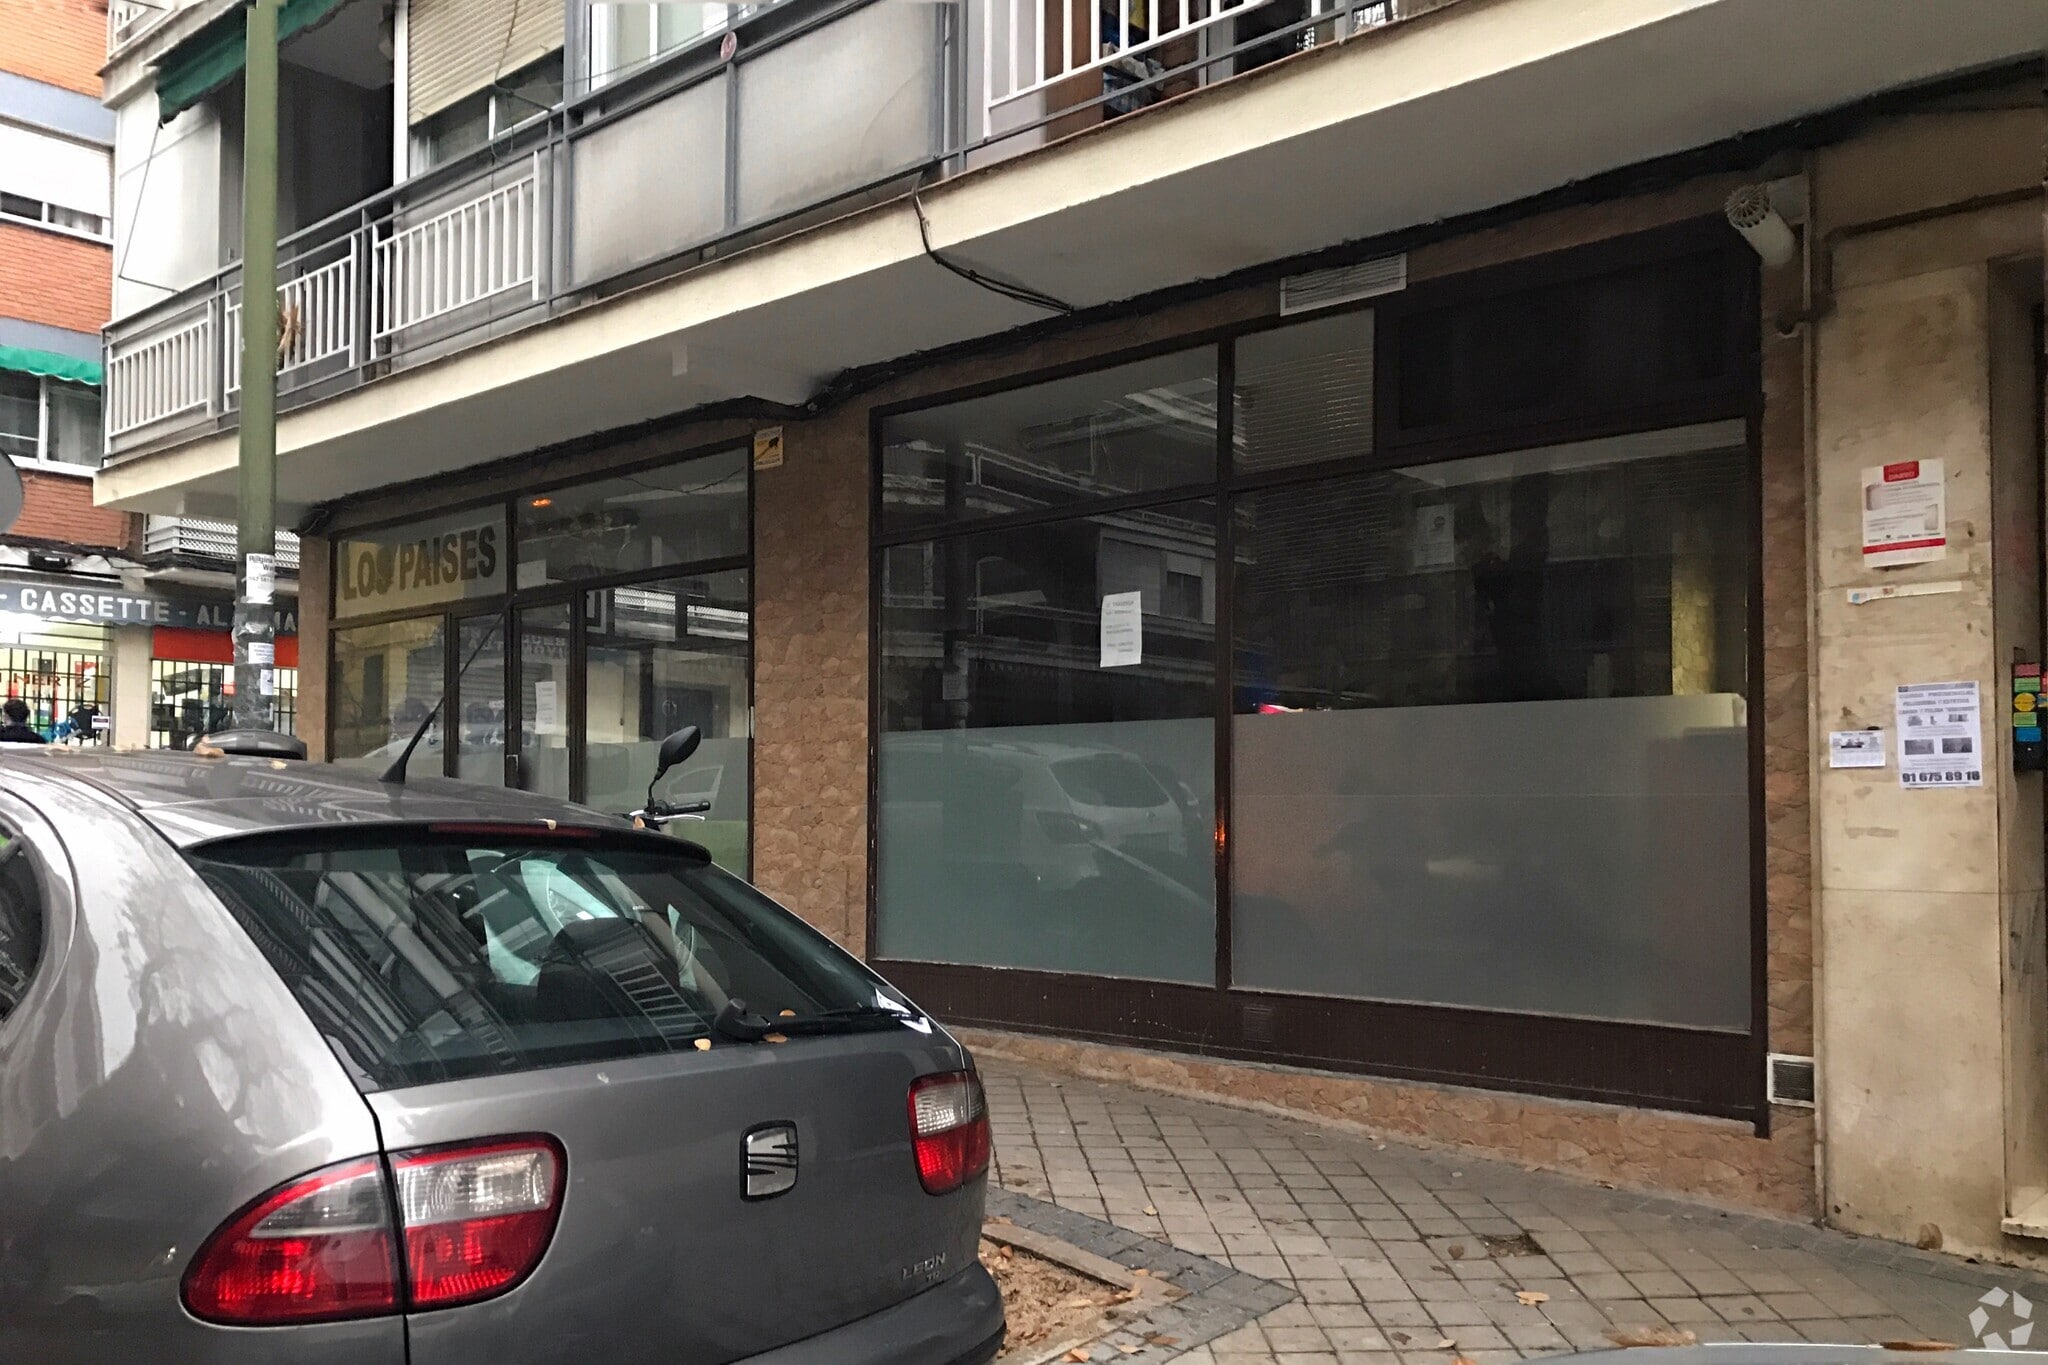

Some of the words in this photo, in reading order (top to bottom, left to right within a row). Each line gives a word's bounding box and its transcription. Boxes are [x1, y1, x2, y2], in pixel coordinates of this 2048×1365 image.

[399, 526, 497, 591] PAISES
[20, 588, 170, 622] CASSETTE
[902, 1252, 946, 1280] LEON
